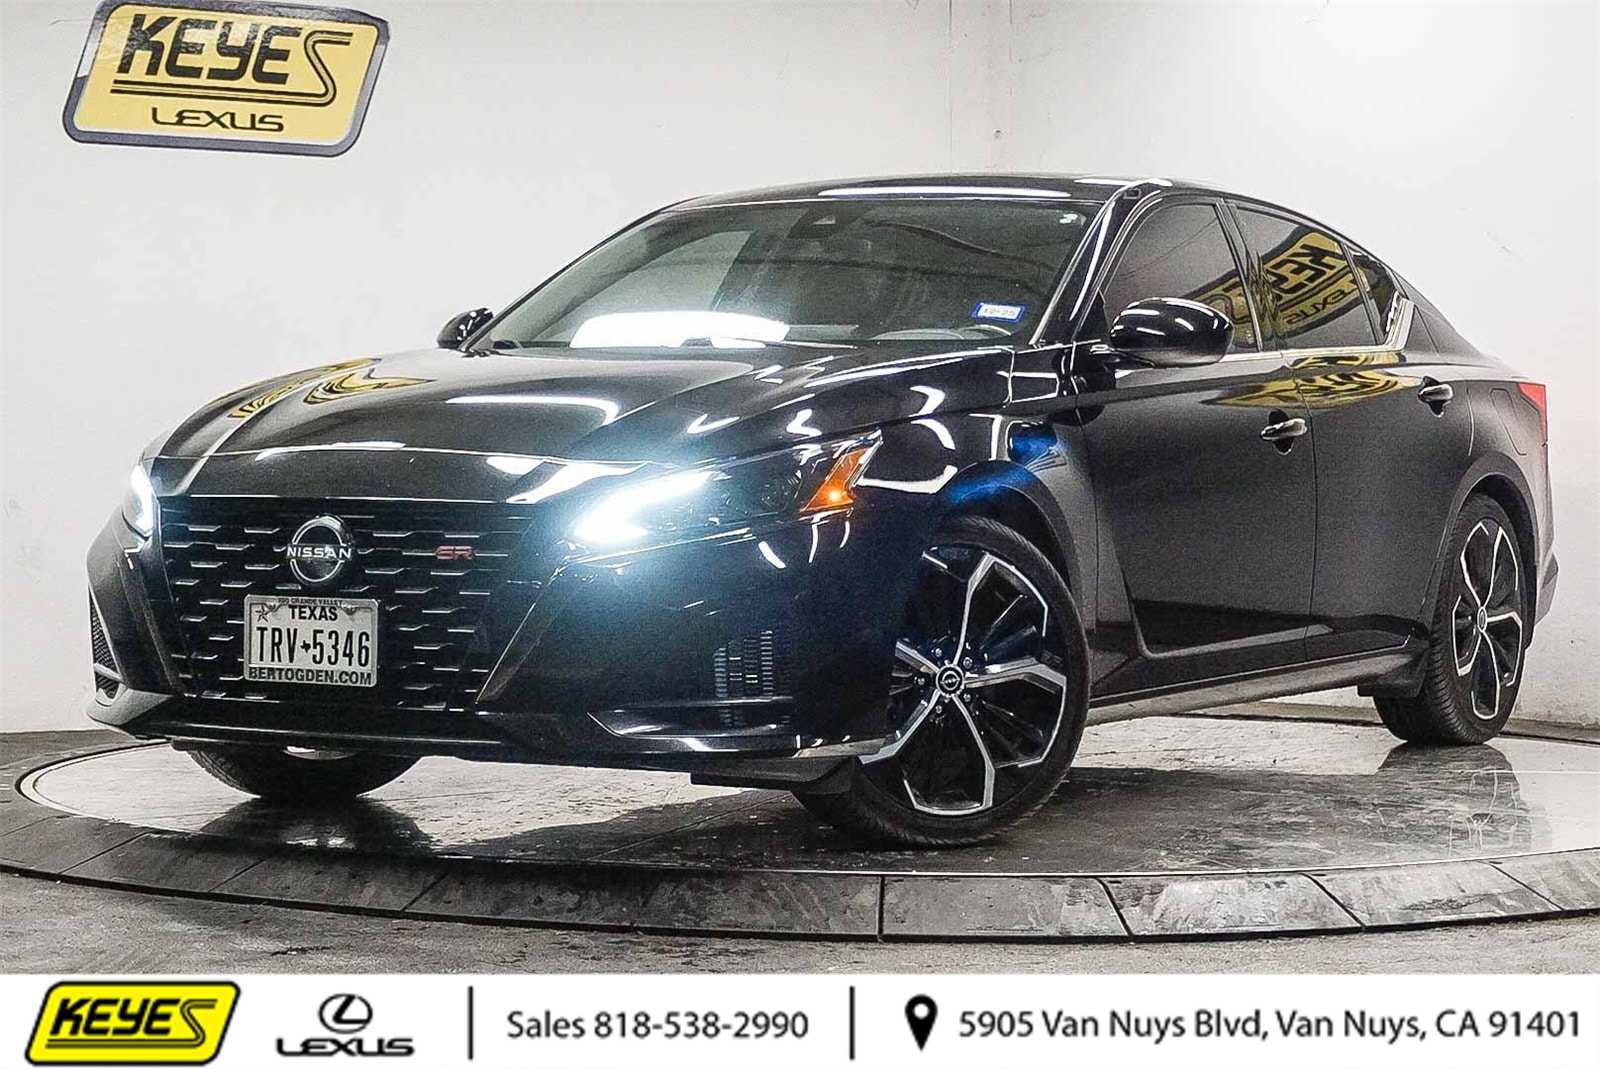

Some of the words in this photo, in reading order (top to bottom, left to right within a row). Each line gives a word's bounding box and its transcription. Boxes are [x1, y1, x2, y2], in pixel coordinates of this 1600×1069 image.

[112, 13, 353, 107] KEYES
[151, 107, 284, 132] LEXUS
[286, 546, 352, 559] NISSAN
[288, 604, 338, 621] TEXAS
[248, 666, 372, 685] BERTOGDEN.COM
